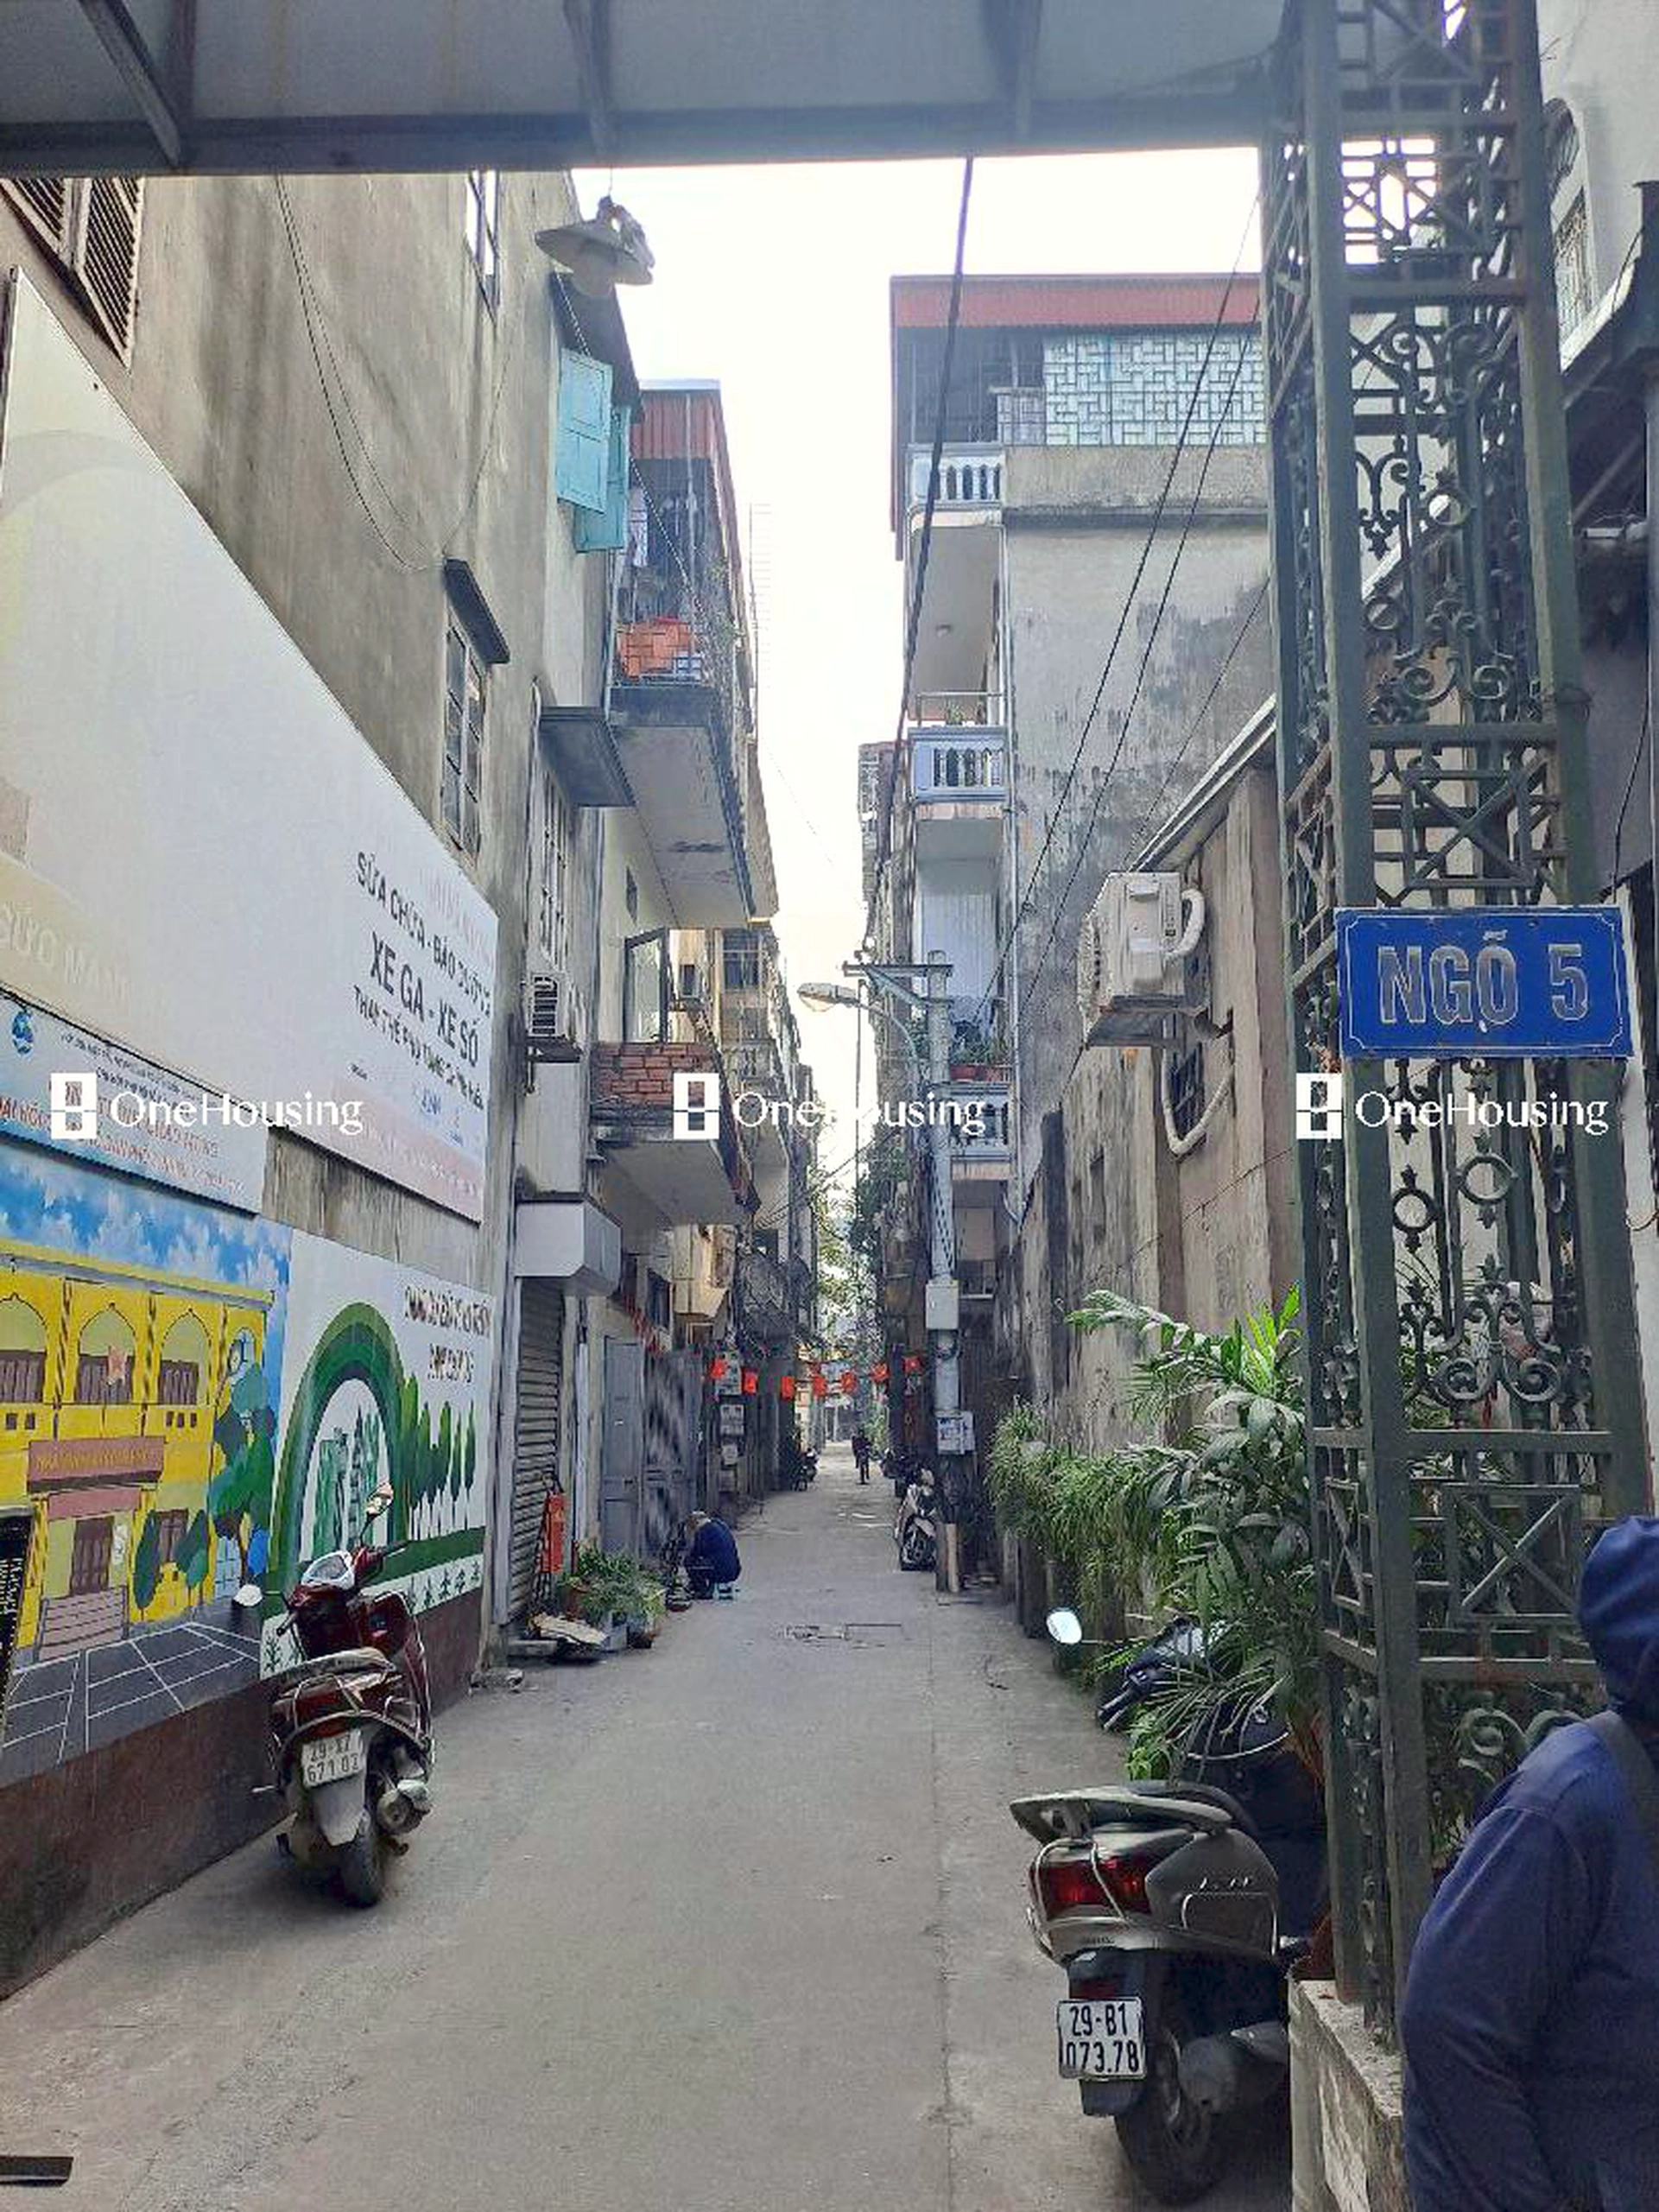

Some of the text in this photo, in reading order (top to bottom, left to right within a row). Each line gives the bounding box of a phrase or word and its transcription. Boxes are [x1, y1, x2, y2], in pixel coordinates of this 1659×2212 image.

[370, 931, 396, 996] XE
[401, 964, 424, 1023] GA
[438, 998, 457, 1049] XE
[460, 1017, 481, 1068] SỐ
[1377, 929, 1589, 1024] NGÕ 5
[1069, 2003, 1128, 2037] 29-B1
[1066, 2039, 1139, 2073] 073.78
